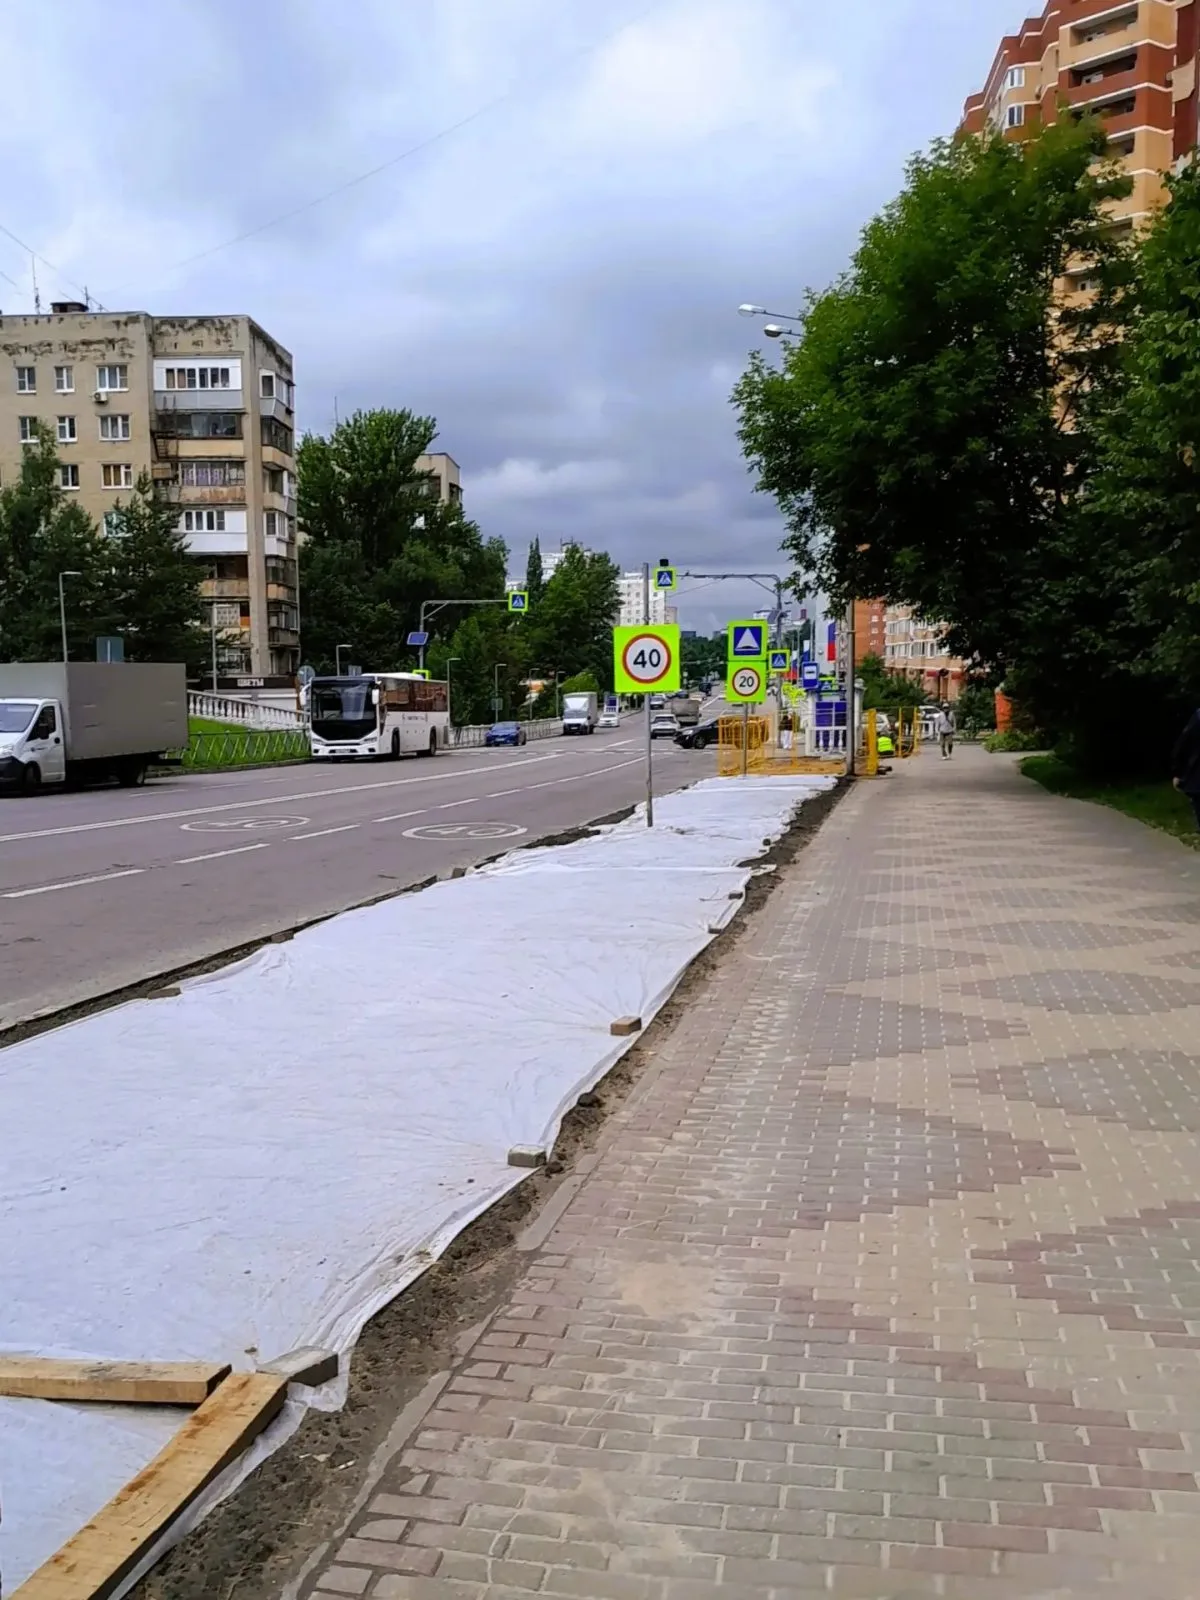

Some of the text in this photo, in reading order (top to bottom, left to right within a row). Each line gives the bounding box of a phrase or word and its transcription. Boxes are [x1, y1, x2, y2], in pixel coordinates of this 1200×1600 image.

[633, 648, 661, 668] 40
[739, 675, 755, 688] 20
[425, 826, 507, 836] 40
